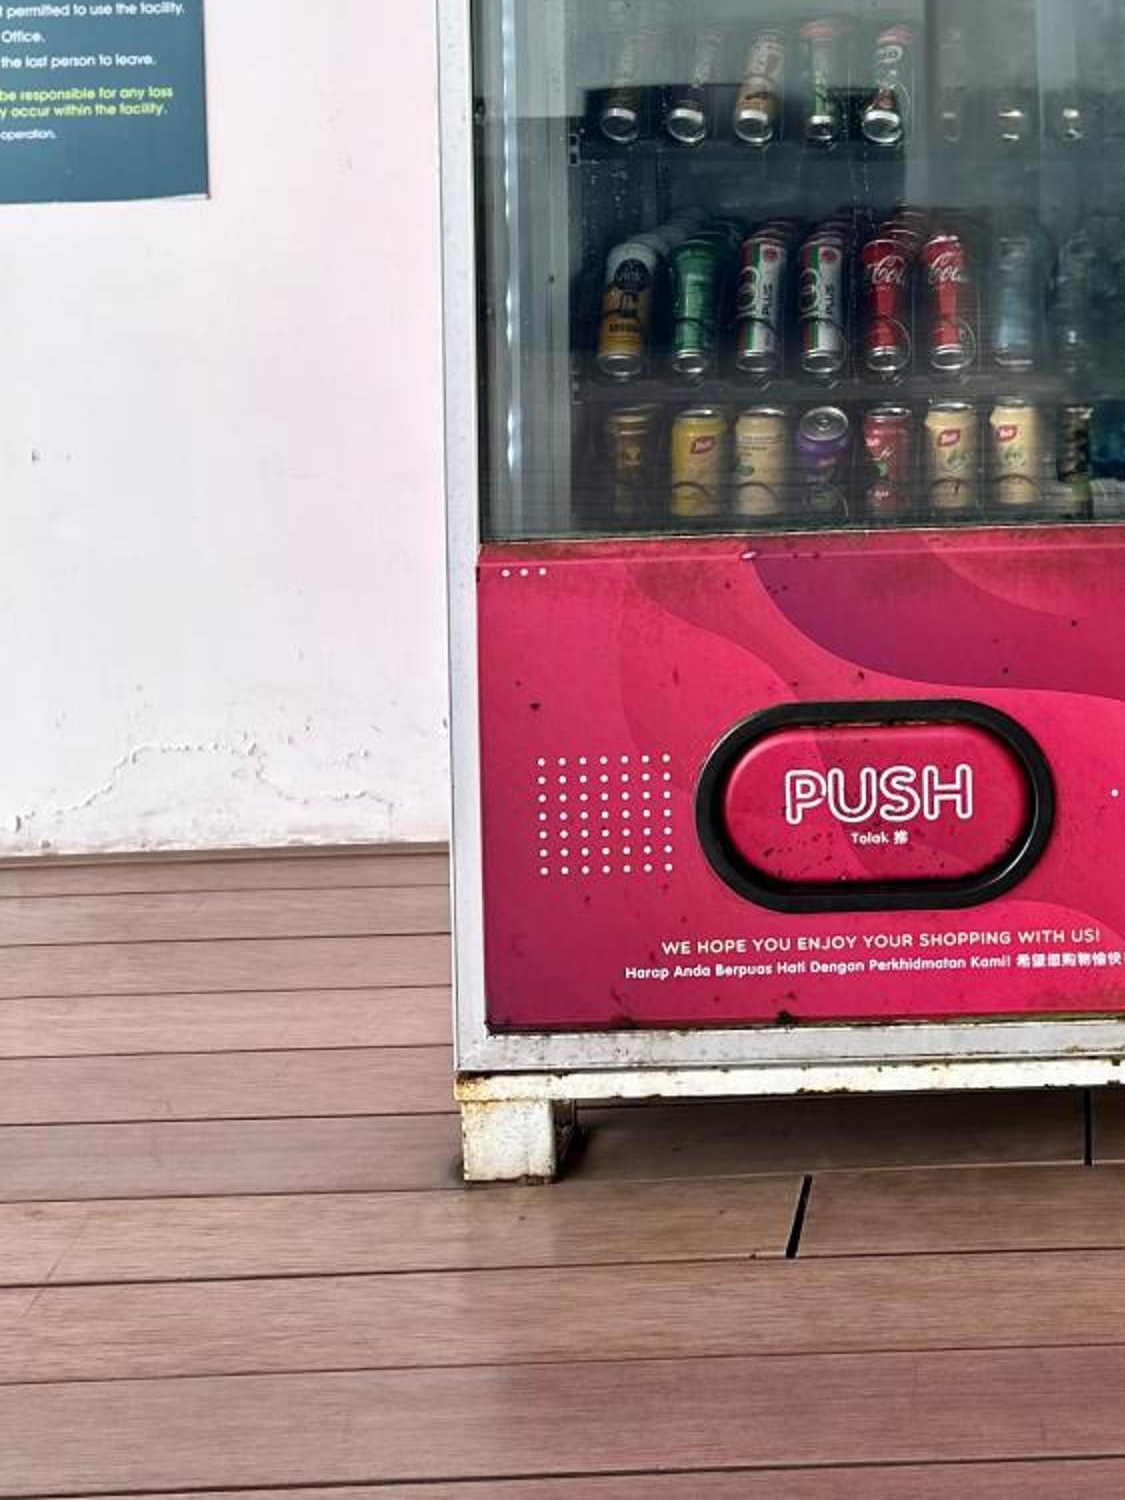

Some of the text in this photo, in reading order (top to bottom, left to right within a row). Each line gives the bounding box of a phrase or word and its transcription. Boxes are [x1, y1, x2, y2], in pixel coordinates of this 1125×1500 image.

[6, 3, 70, 18] permitted
[74, 4, 87, 15] to
[90, 4, 112, 15] use
[116, 2, 137, 14] the
[1, 30, 46, 43] Office.
[1, 53, 157, 69] the last person to leave.
[20, 87, 96, 104] responsible
[99, 87, 117, 99] for
[120, 87, 145, 100] any
[149, 85, 174, 98] loss
[11, 107, 50, 118] occur
[54, 104, 93, 117] within
[95, 103, 117, 116] the
[785, 763, 974, 825] PUSH
[851, 832, 890, 845] Tolak
[661, 928, 1099, 955] WE HOPE YOU ENJOY YOUR SHOPPING WITH US!
[625, 967, 669, 980] Harap
[673, 965, 711, 977] Anda
[715, 963, 773, 978] Berpuas
[777, 962, 806, 974] Hati
[810, 960, 864, 975] Dengan
[869, 956, 967, 971] Perkhidmatan
[970, 955, 1011, 969] Kami!
